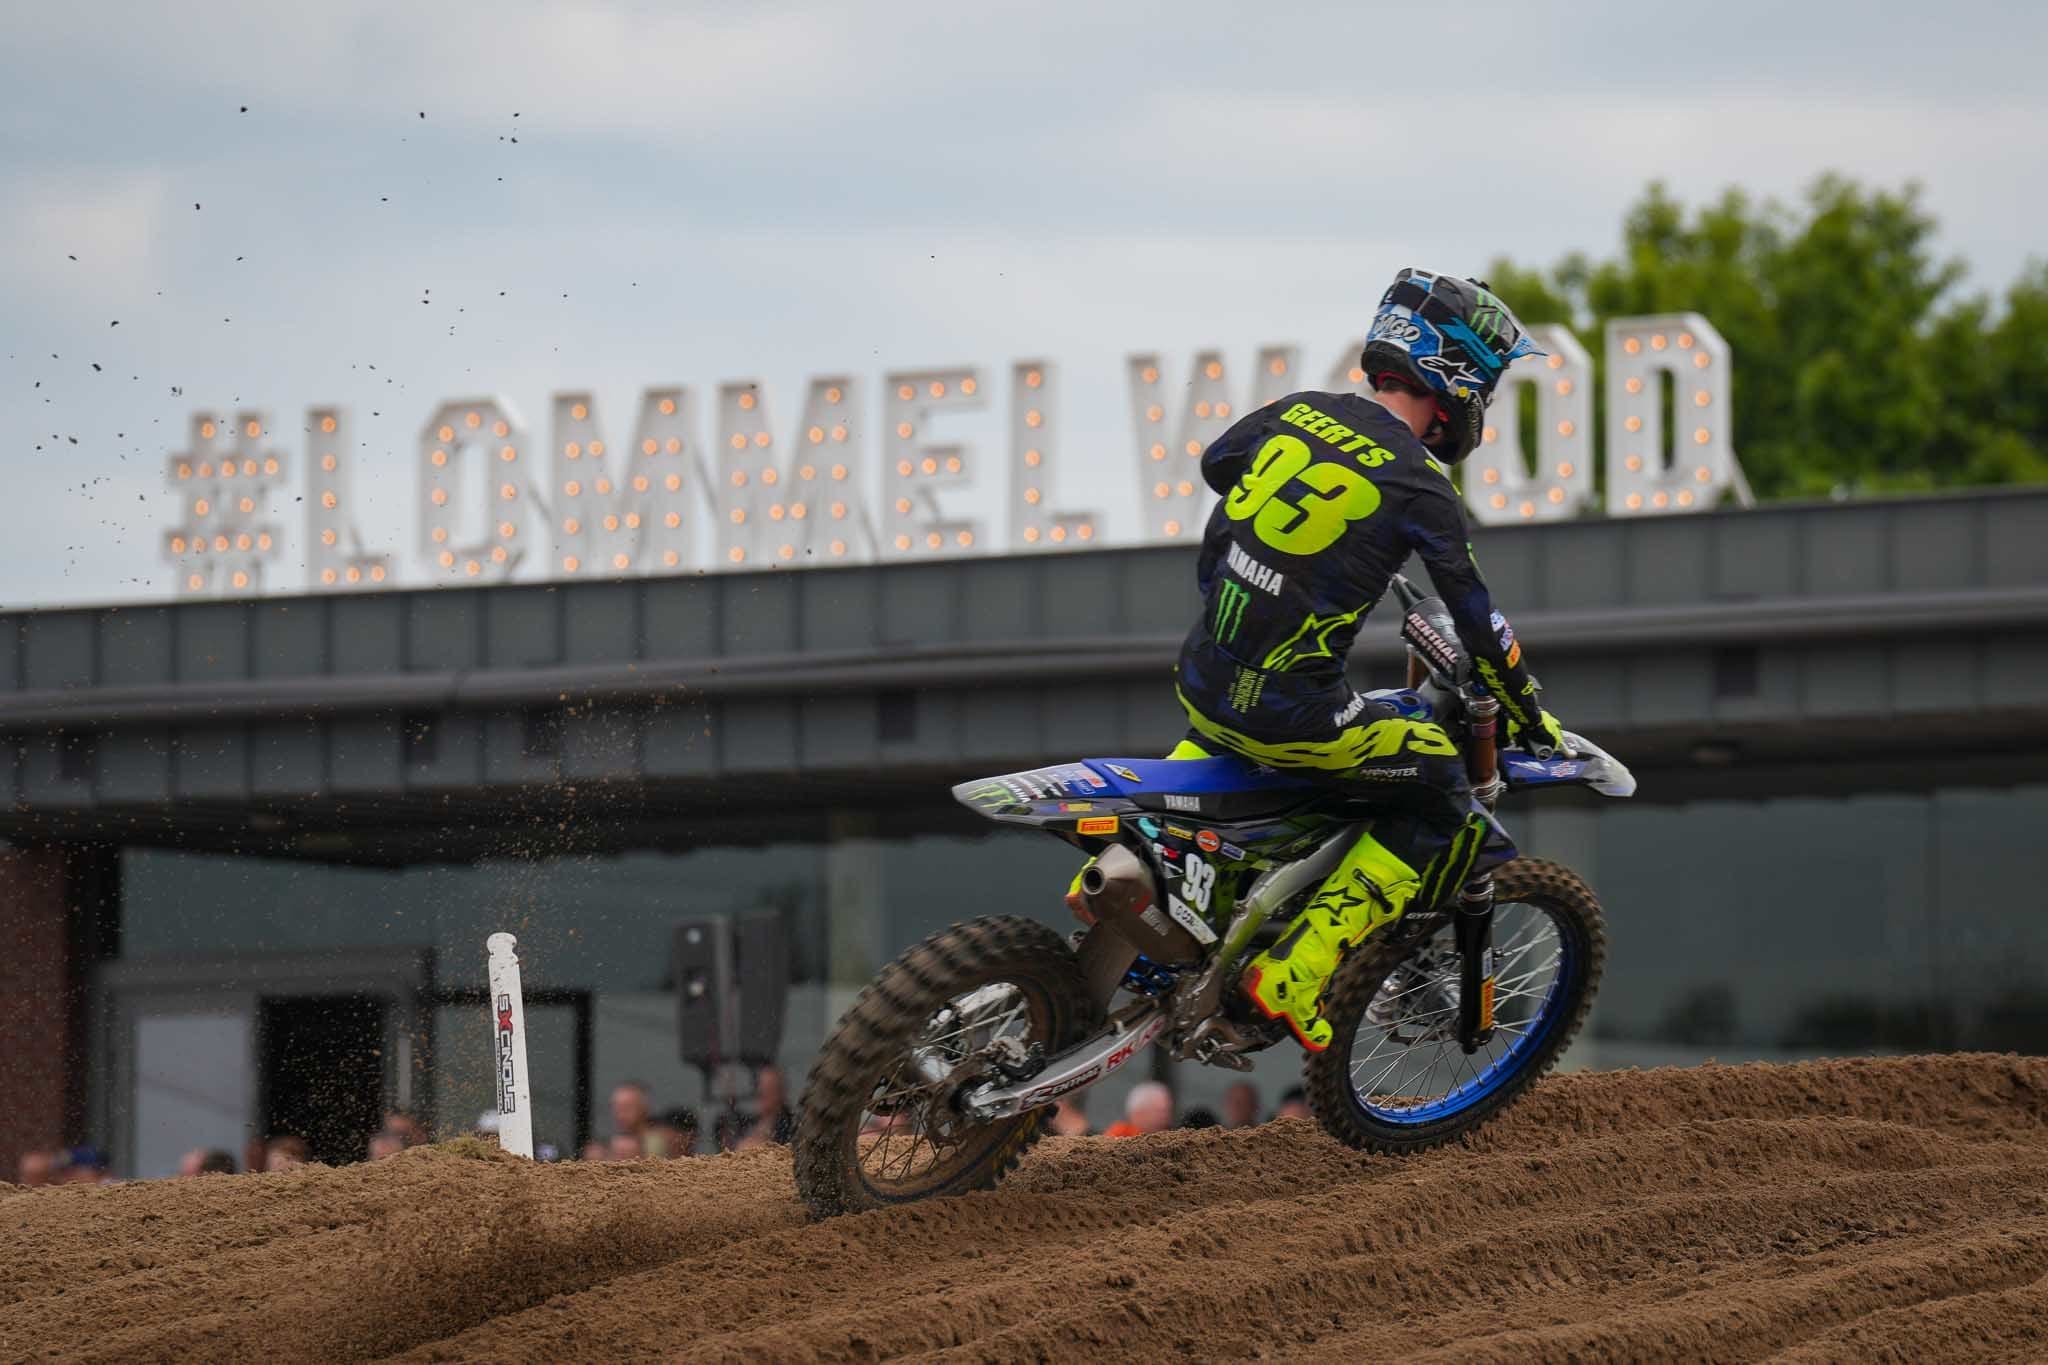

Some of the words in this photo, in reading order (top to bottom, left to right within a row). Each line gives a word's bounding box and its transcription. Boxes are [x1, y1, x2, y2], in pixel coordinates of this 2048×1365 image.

[162, 312, 1732, 597] #LOMMELWOD
[1280, 402, 1396, 469] GEERTS
[1225, 434, 1381, 556] 93
[1407, 612, 1459, 664] RENTHAL
[1181, 852, 1216, 912] 93
